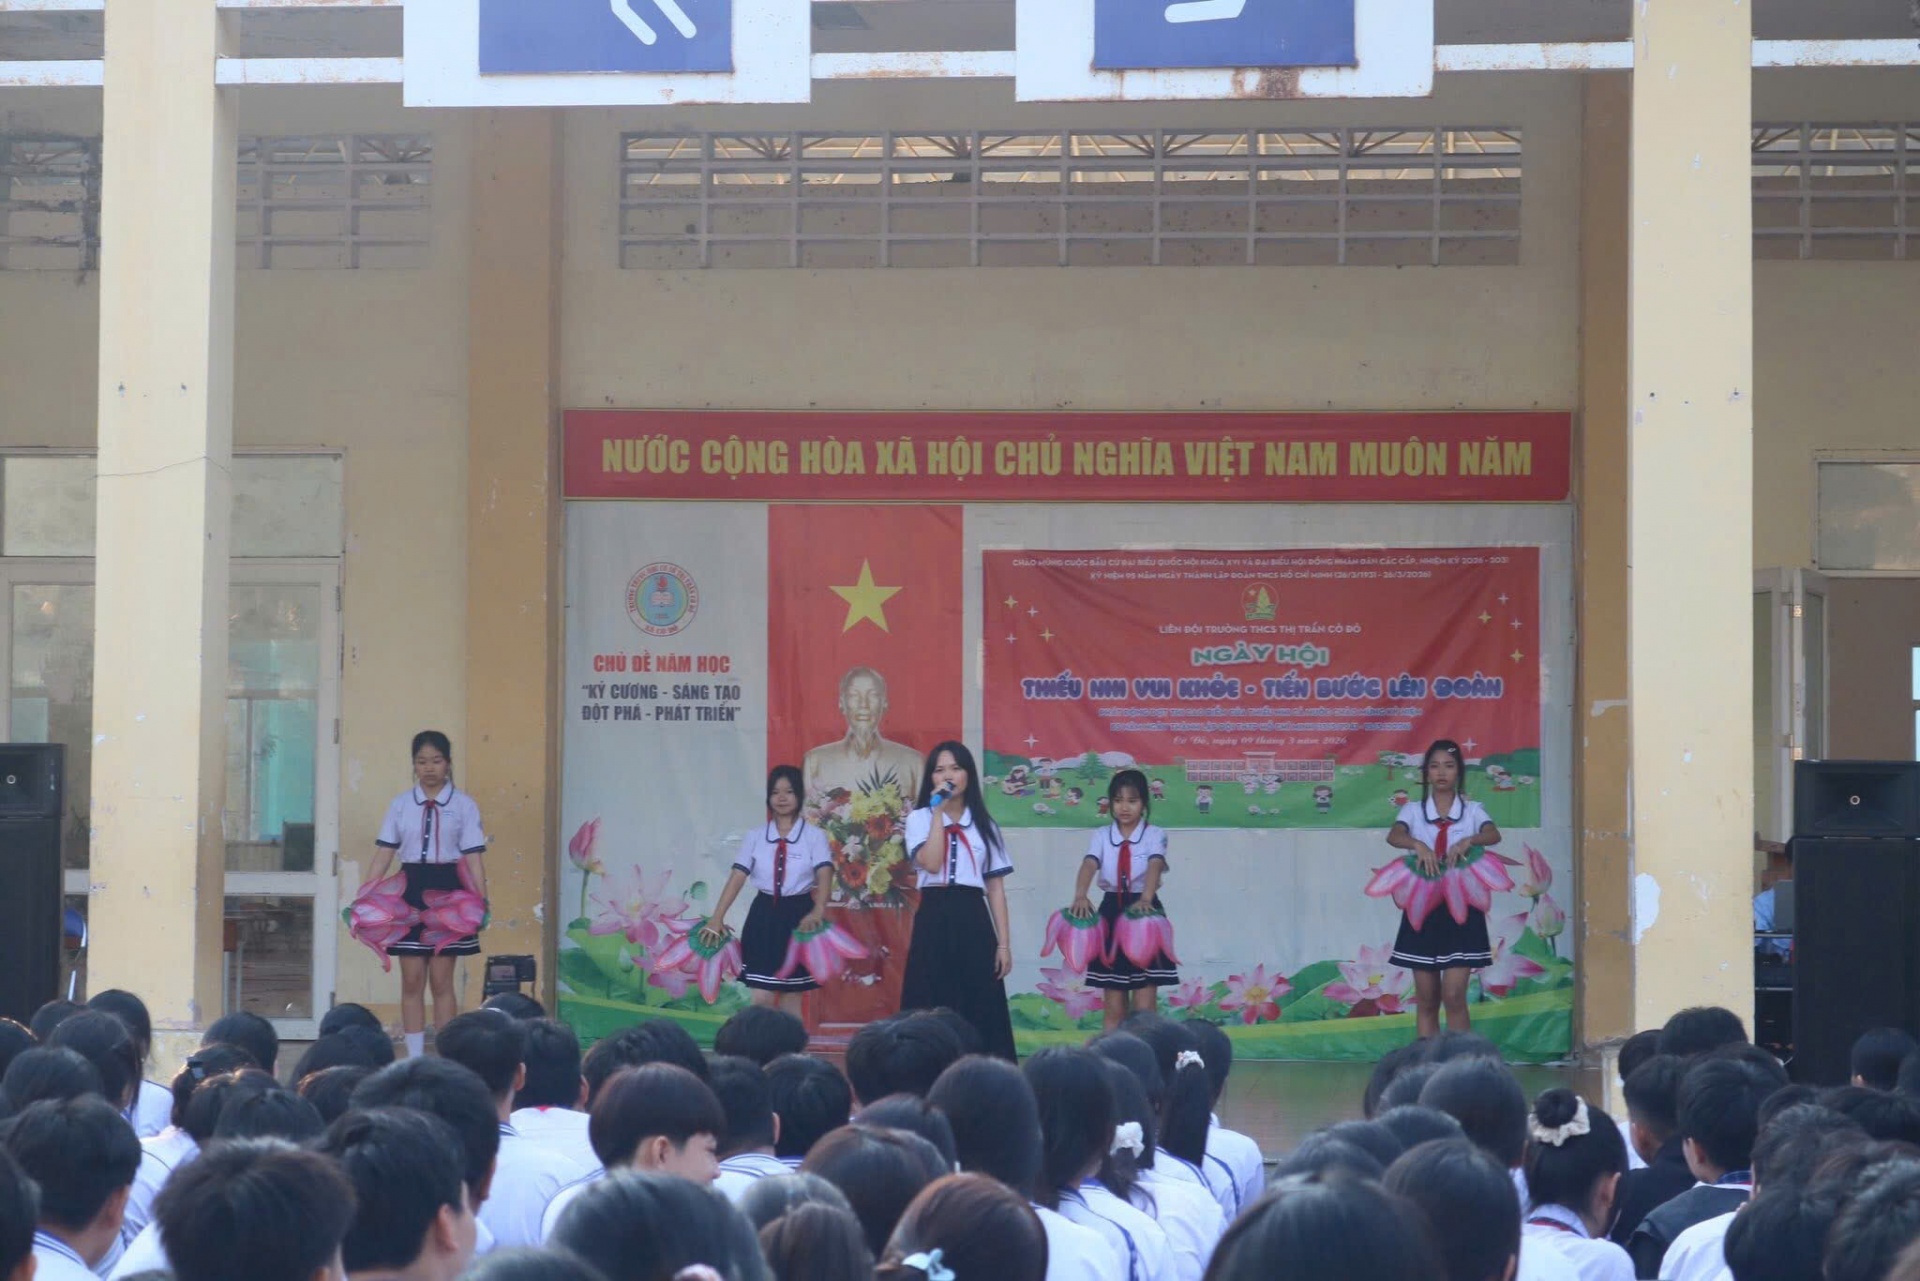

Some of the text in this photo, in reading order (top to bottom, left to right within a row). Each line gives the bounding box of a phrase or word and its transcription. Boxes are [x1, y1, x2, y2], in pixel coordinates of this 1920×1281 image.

[602, 432, 1532, 482] NƯỚC CỘNG HÒA XÃ HỘI CHỦ NGHĨA VIỆT NAM MUÔN NĂM
[1159, 622, 1182, 634] LIÊN
[1183, 622, 1203, 636] ĐỘI
[1204, 622, 1248, 634] TRƯỜNG
[1249, 625, 1277, 634] THCS
[1279, 625, 1297, 636] THỊ
[1298, 621, 1326, 634] TRẤN
[593, 649, 731, 677] CHỦ ĐỀ NĂM HỌC
[1191, 640, 1330, 668] NGÀY HỘI
[610, 682, 658, 700] CƯƠNG
[672, 682, 709, 700] SÁNG
[1021, 669, 1504, 699] THIẾU NHI VUI KHỎE - TIẾN BƯỚC LÊN ĐOÀN
[581, 703, 609, 723] ĐỘT
[614, 703, 641, 721] PHÁ
[655, 703, 691, 721] PHÁT
